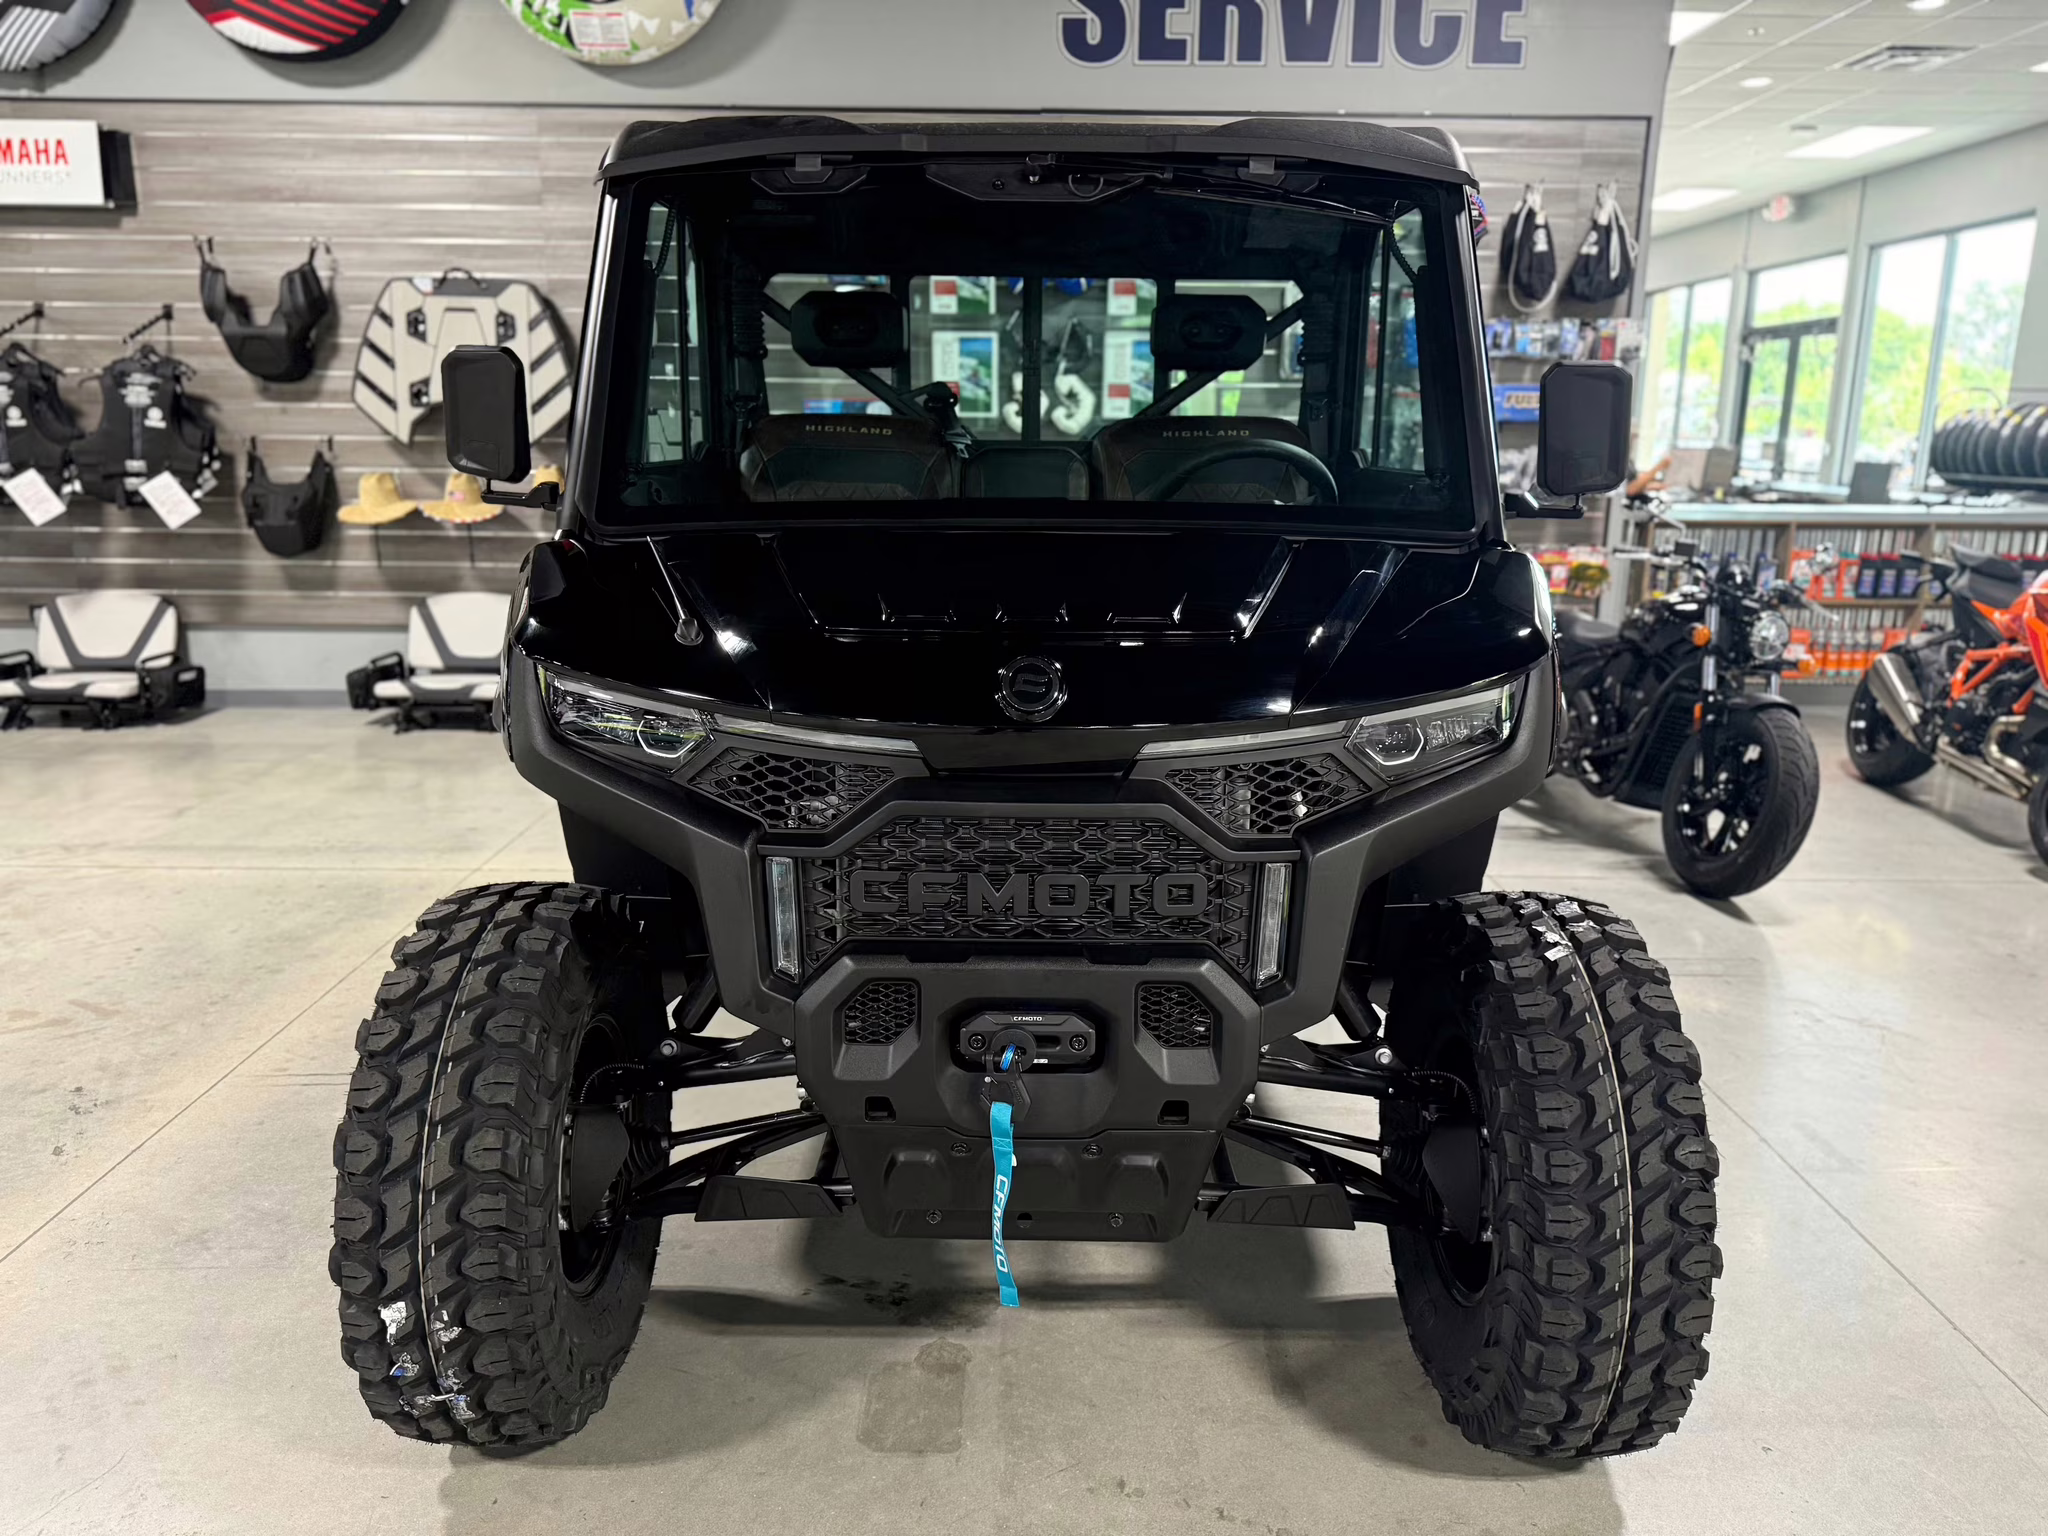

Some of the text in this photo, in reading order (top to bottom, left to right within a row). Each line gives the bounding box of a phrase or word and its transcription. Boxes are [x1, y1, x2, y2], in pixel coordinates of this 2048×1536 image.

[805, 425, 893, 435] HIGHLAND
[1162, 430, 1250, 438] HIGHLAND
[849, 870, 1208, 918] CFMOTO
[995, 1174, 1009, 1273] CFMOTO
